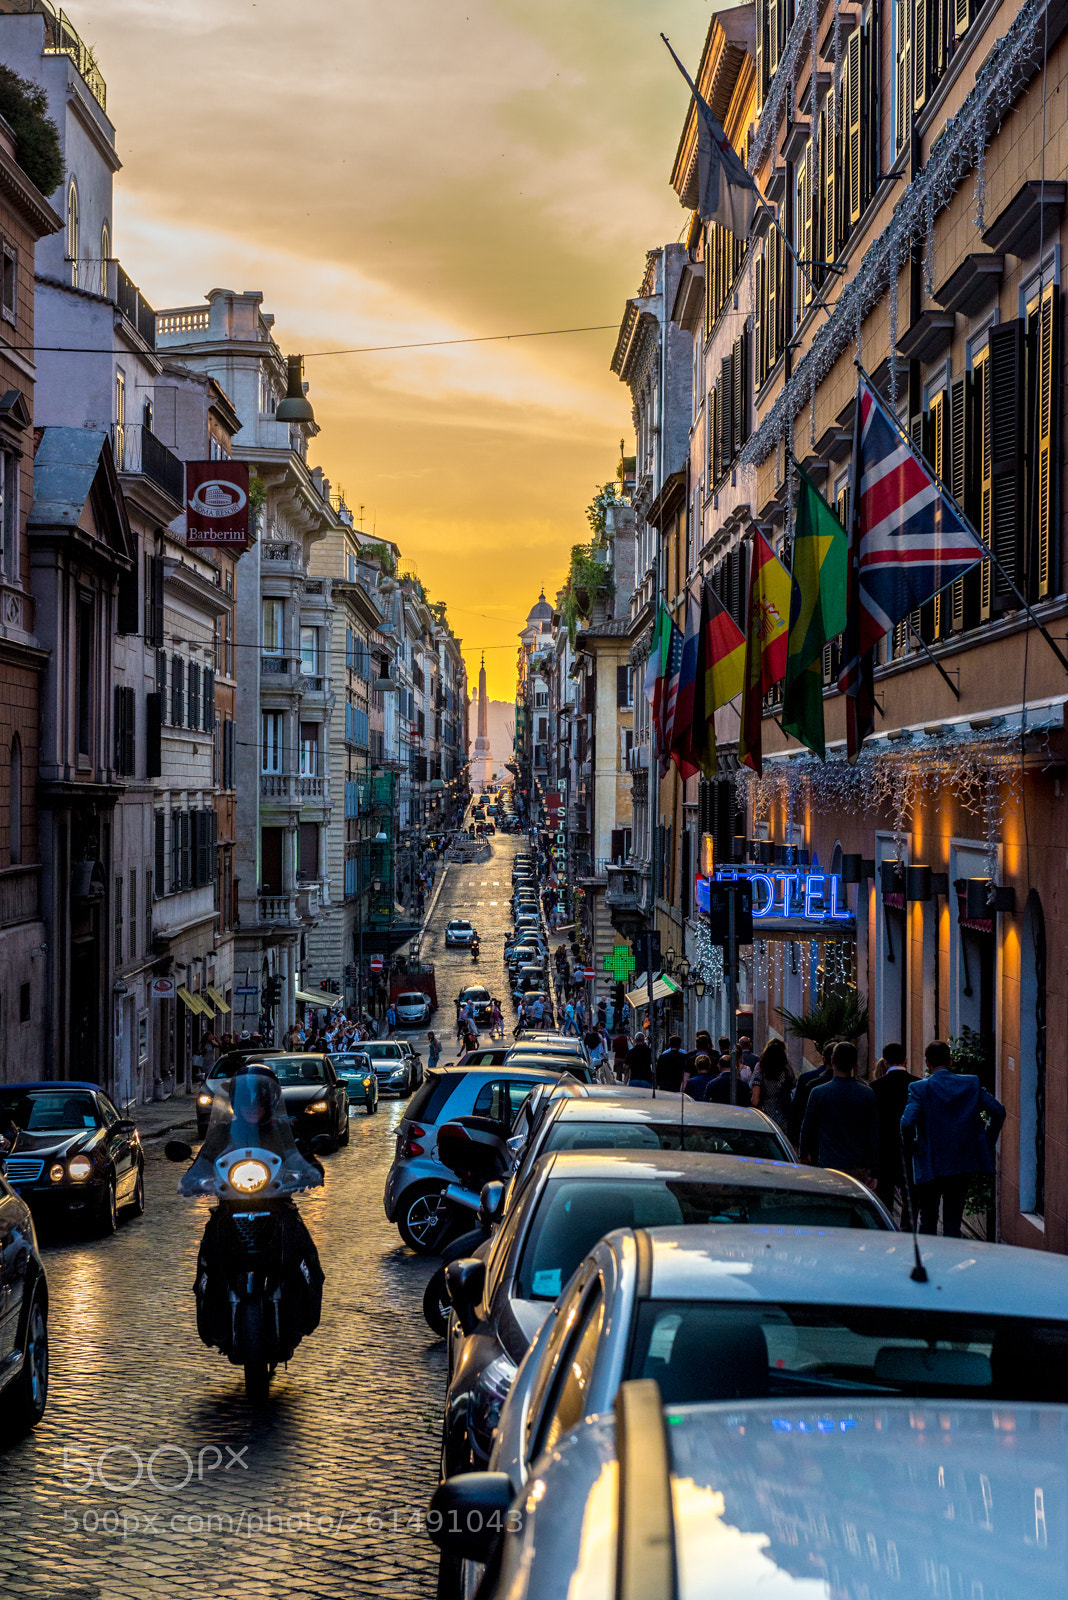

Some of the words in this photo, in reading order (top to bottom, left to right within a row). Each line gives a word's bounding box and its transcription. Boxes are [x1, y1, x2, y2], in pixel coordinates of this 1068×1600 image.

[194, 503, 213, 516] ROMA
[216, 504, 241, 517] RESORT
[189, 527, 245, 540] Barberini
[717, 872, 850, 918] OTEL
